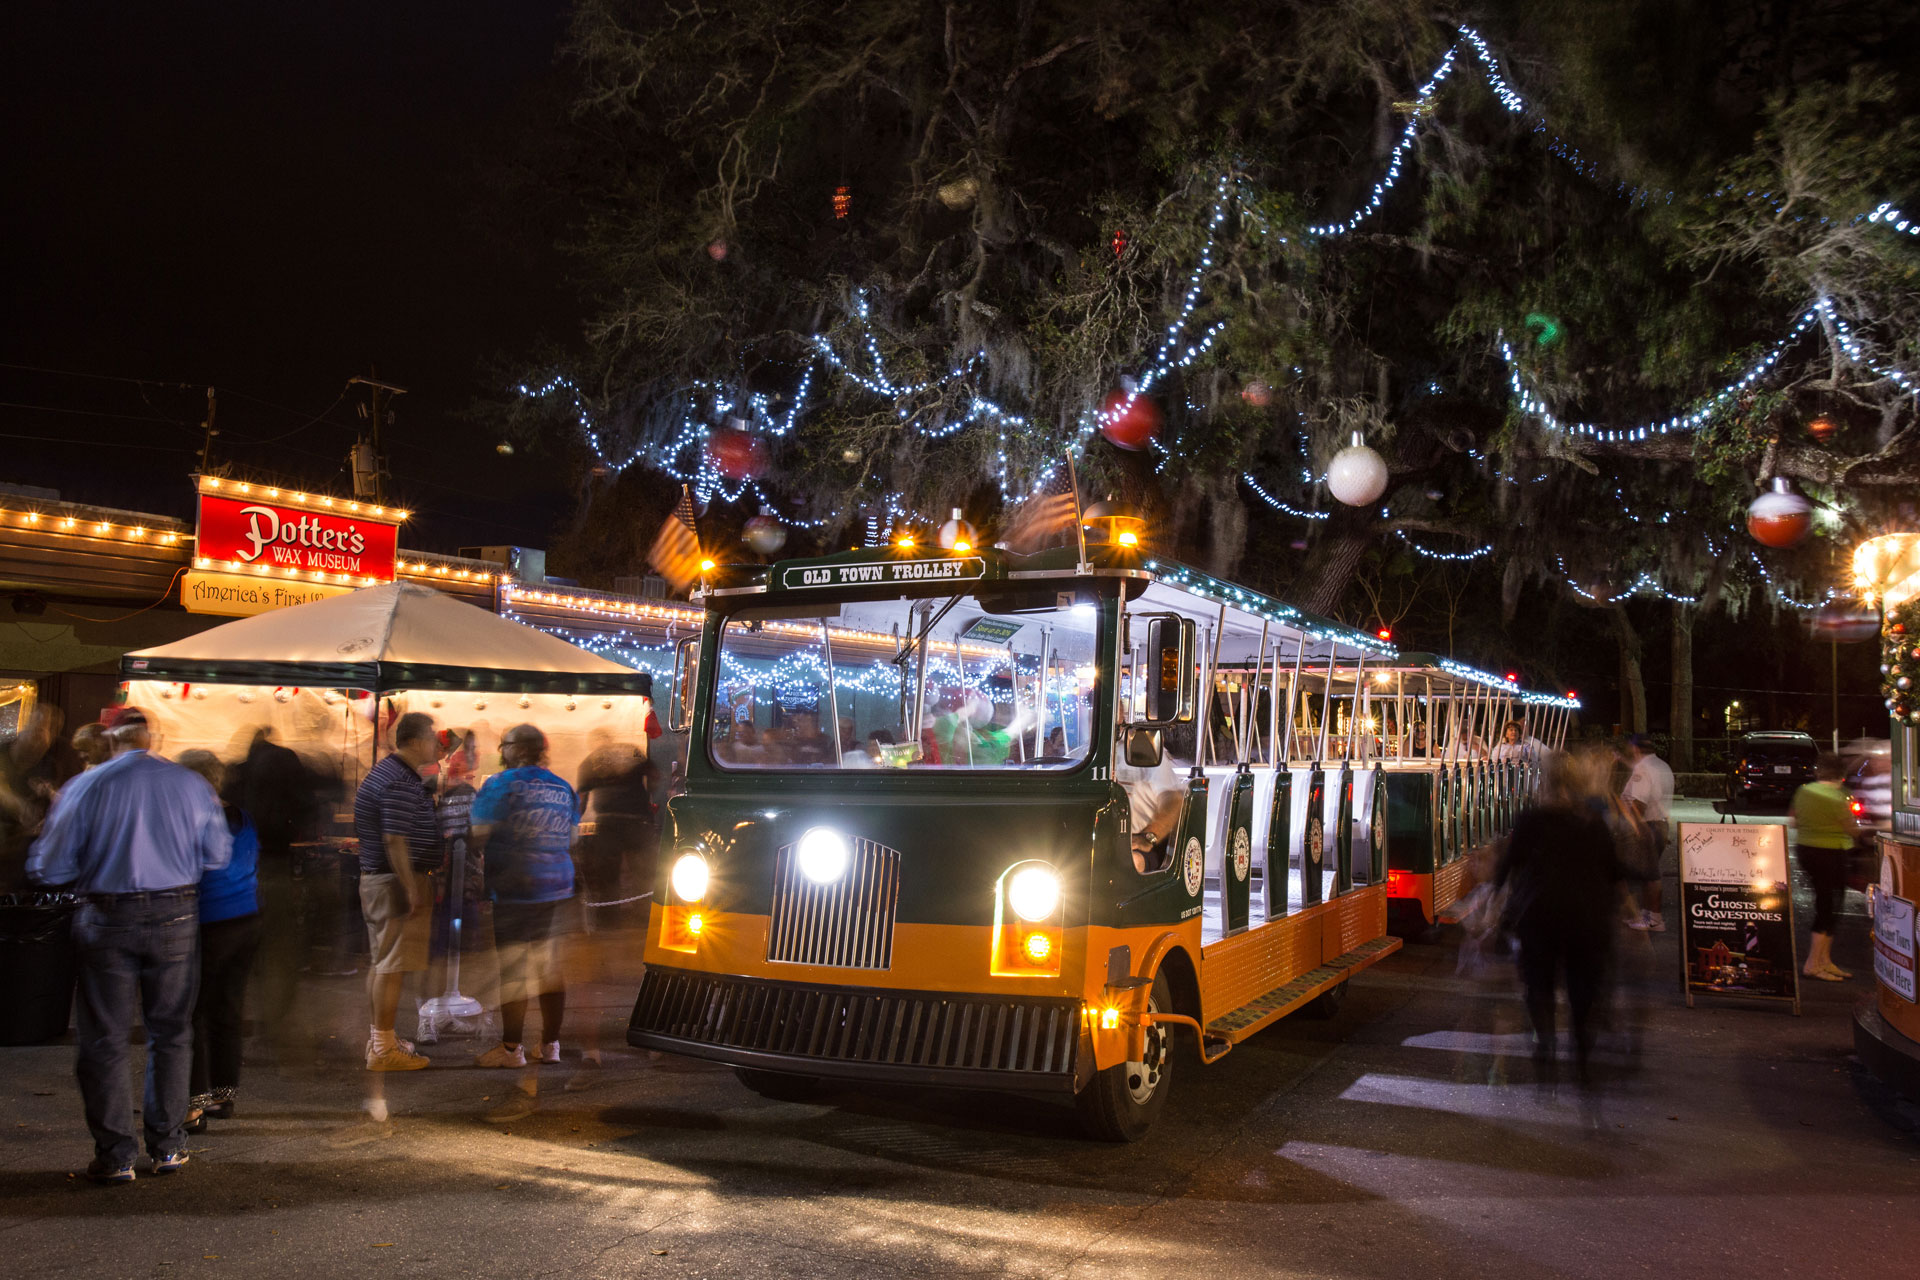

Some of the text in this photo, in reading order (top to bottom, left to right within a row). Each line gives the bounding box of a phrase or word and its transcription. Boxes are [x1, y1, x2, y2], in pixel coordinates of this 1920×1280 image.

[236, 506, 365, 562] Potter's
[272, 546, 361, 572] WAX MUSEUM
[803, 562, 963, 585] OLD TOWN TROLLEY
[193, 580, 270, 605] America's
[275, 587, 306, 606] First
[1091, 766, 1108, 781] 11
[1120, 819, 1127, 833] 11
[1691, 903, 1782, 922] GRAVESTONES
[1707, 894, 1757, 910] GHOSTS
[1895, 968, 1912, 993] Here
